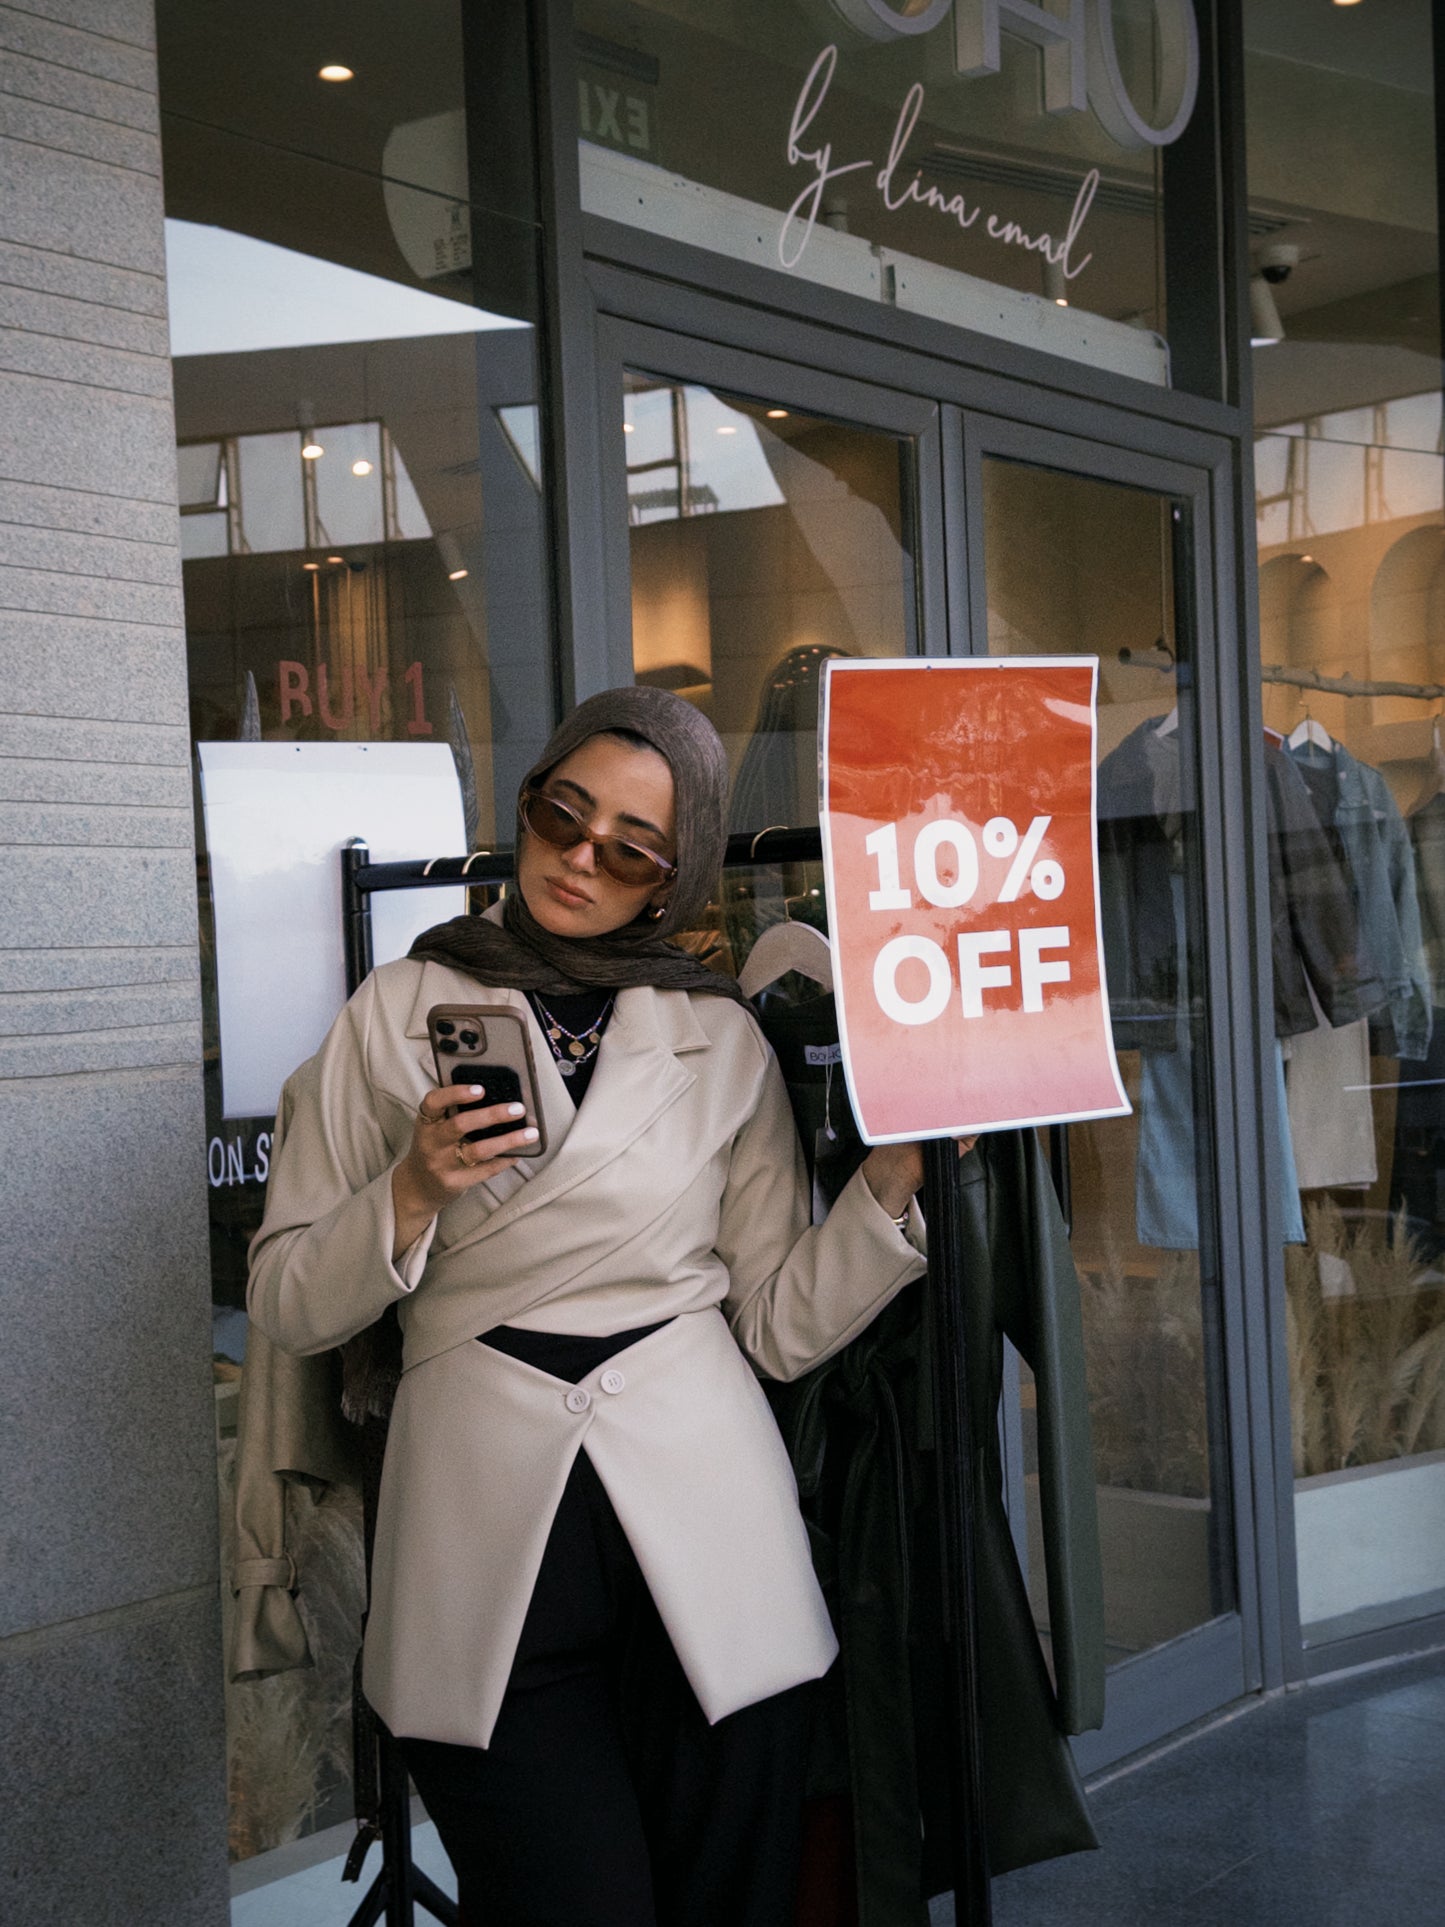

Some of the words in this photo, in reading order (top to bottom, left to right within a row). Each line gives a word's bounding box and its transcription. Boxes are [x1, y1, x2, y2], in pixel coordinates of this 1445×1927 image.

[830, 0, 1199, 148] HO
[778, 44, 873, 268] by
[876, 82, 981, 228] dina
[986, 168, 1100, 279] emad
[404, 661, 433, 734] 1
[865, 816, 1066, 911] 10%
[873, 926, 1072, 1026] OFF
[208, 1136, 245, 1188] ON
[254, 1132, 275, 1183] S
